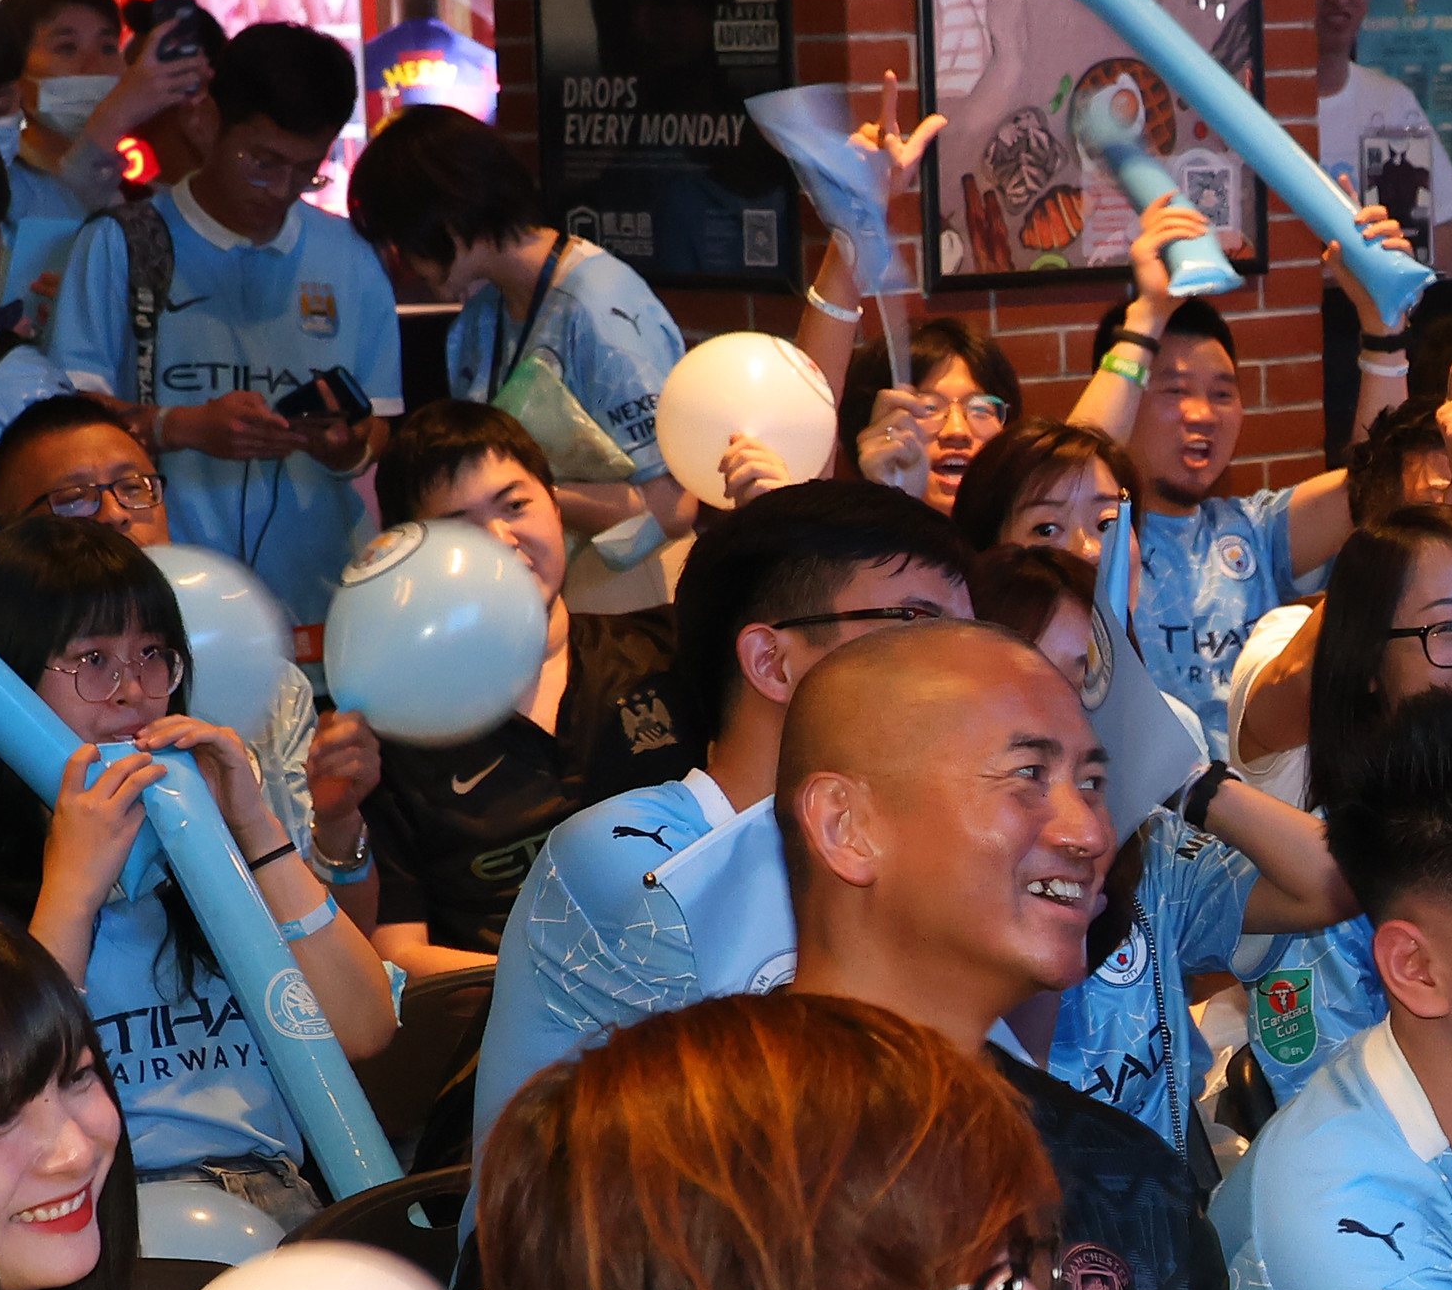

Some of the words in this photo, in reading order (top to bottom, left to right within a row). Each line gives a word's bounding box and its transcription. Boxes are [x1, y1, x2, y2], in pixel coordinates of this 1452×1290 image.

[563, 75, 640, 109] DROPS
[564, 113, 635, 147] EVERY
[639, 112, 747, 147] MONDAY
[162, 363, 316, 394] ETIHA
[1121, 966, 1140, 983] CITY
[94, 994, 246, 1056] TIHA
[1261, 1006, 1310, 1031] Carabao
[1276, 1021, 1299, 1039] Cup
[1291, 1046, 1306, 1057] EFL
